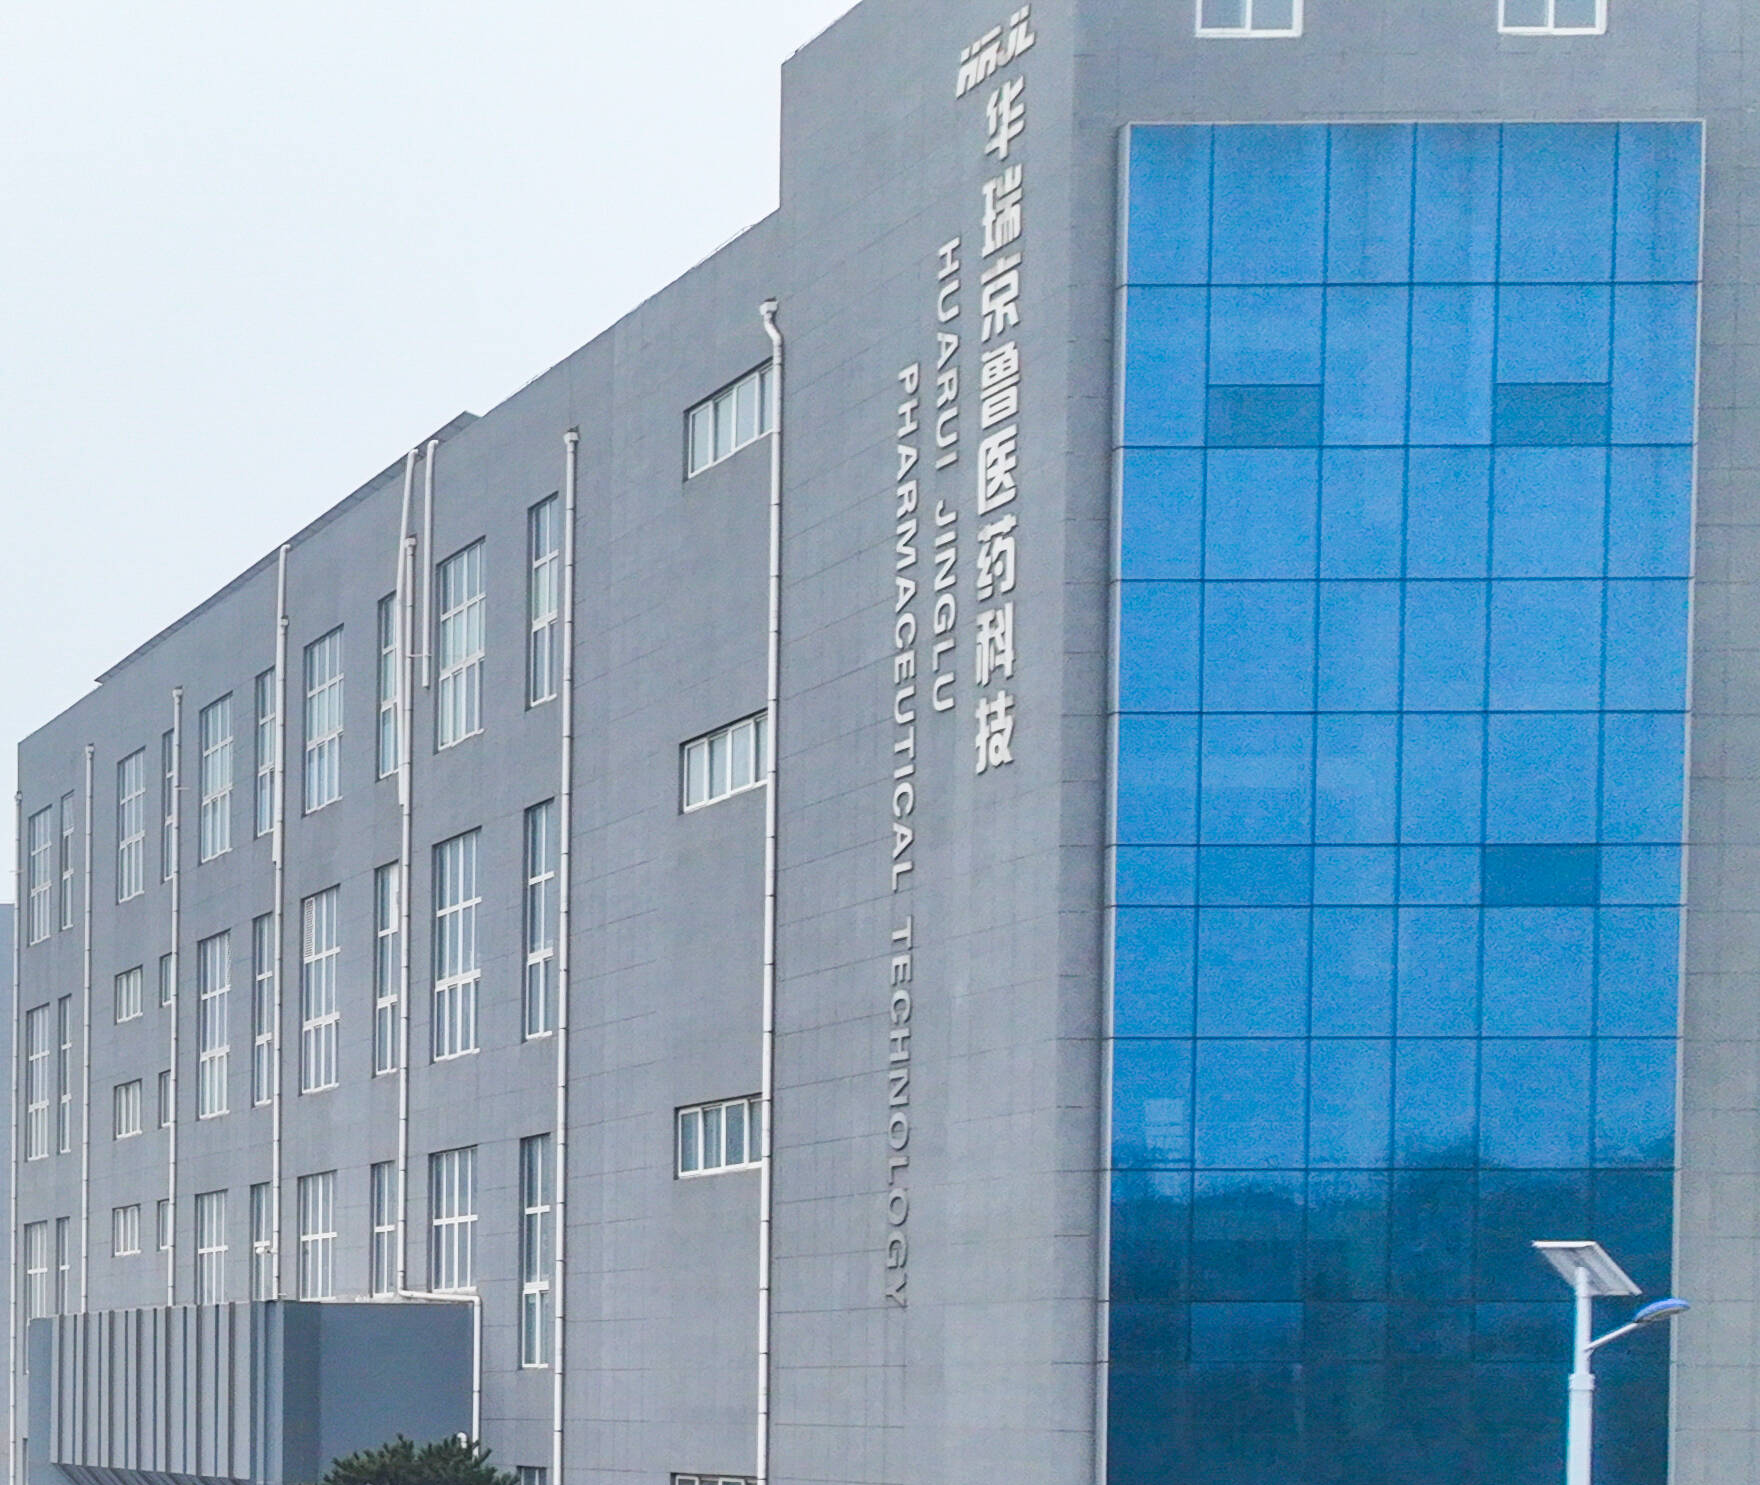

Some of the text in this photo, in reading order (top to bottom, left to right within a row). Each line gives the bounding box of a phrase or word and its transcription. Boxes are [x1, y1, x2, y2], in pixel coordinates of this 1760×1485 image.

[934, 236, 961, 713] HUARUI JINGLU
[975, 75, 1026, 775] 华瑞京鲁医药科技
[886, 362, 920, 1309] PHARMACEUTICAL TECHNOLOGY
